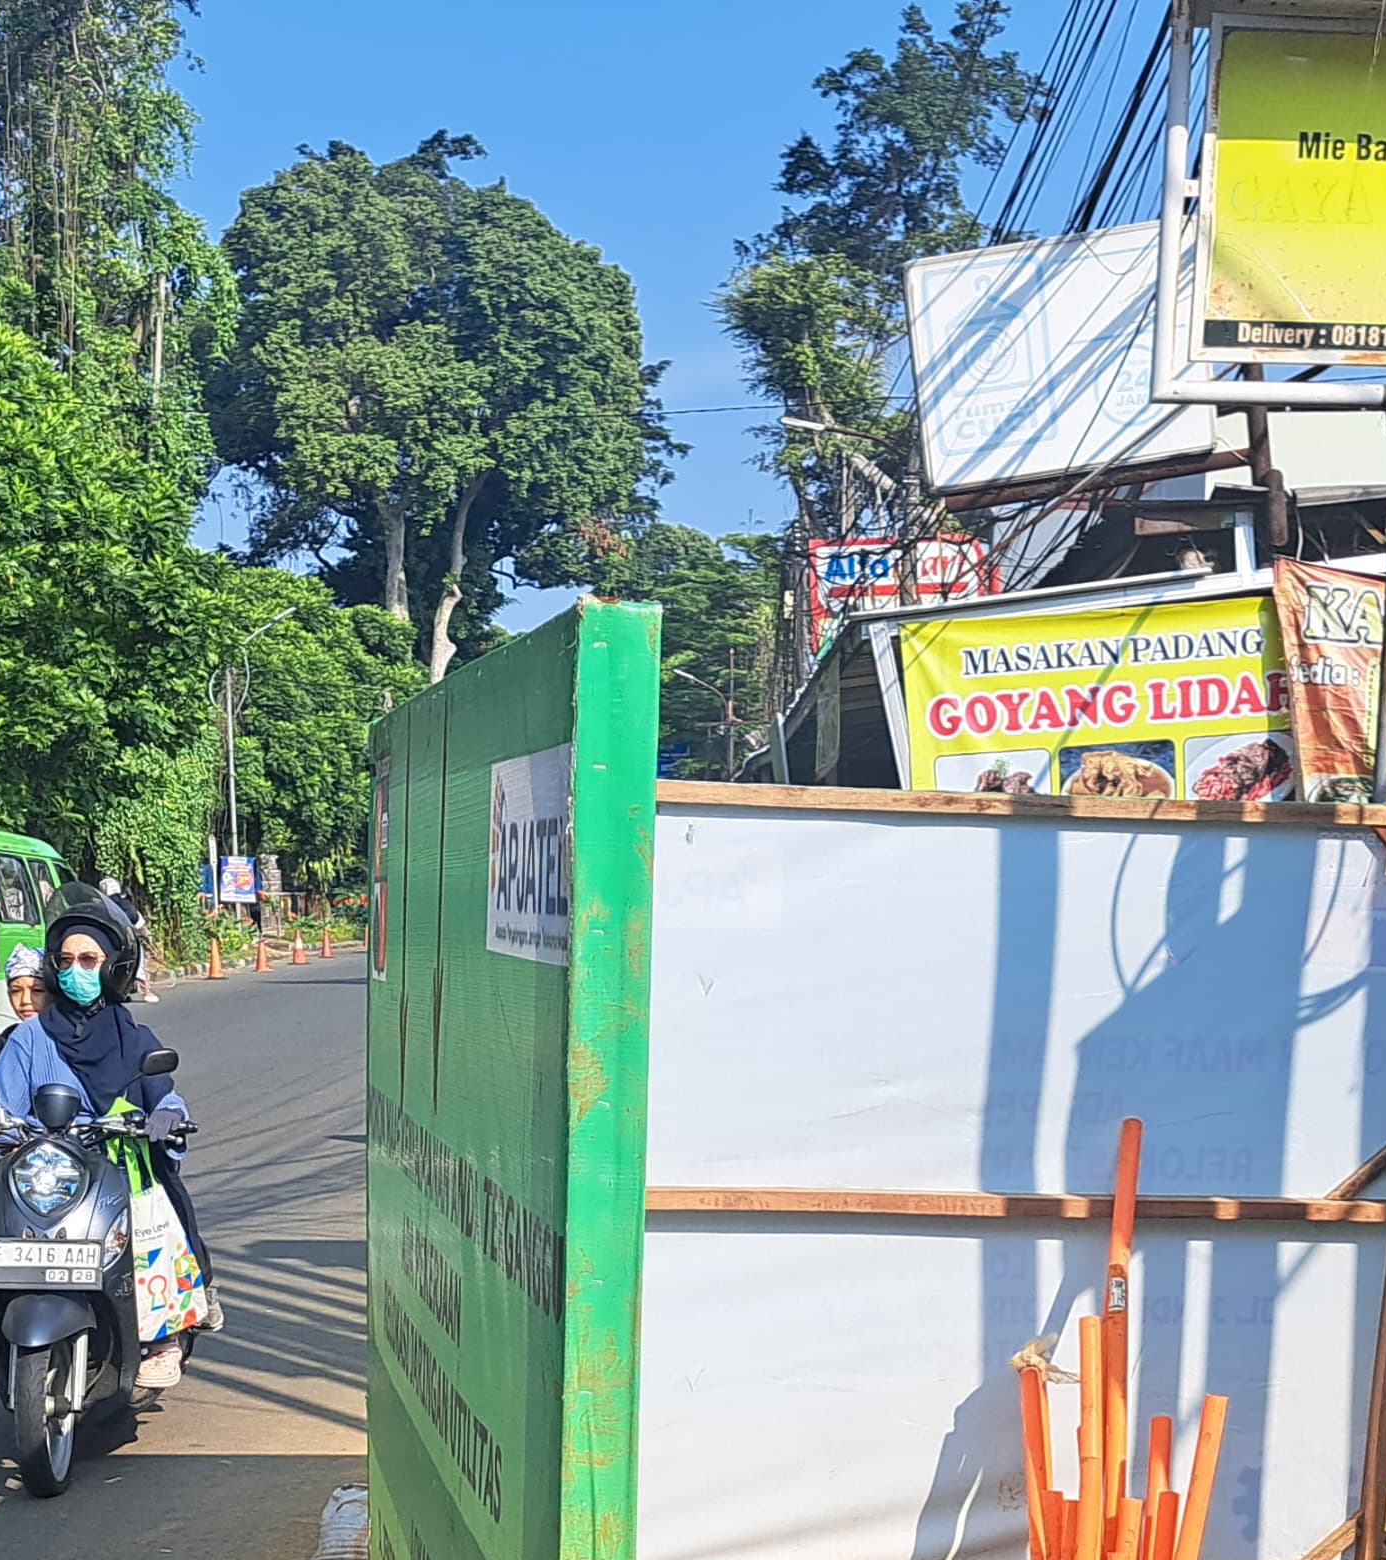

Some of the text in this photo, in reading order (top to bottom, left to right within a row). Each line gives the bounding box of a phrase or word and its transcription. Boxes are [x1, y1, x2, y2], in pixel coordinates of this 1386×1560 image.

[1297, 131, 1346, 161] Mie
[1237, 323, 1315, 350] Delivery
[961, 625, 1265, 678] MASAKAN PADANG
[926, 683, 1137, 738] GOYANG
[496, 815, 569, 917] APJATEL
[14, 1246, 56, 1263] 3416
[64, 1247, 97, 1265] AAH
[47, 1270, 94, 1281] 02 28
[449, 1379, 503, 1525] UTILITAS
